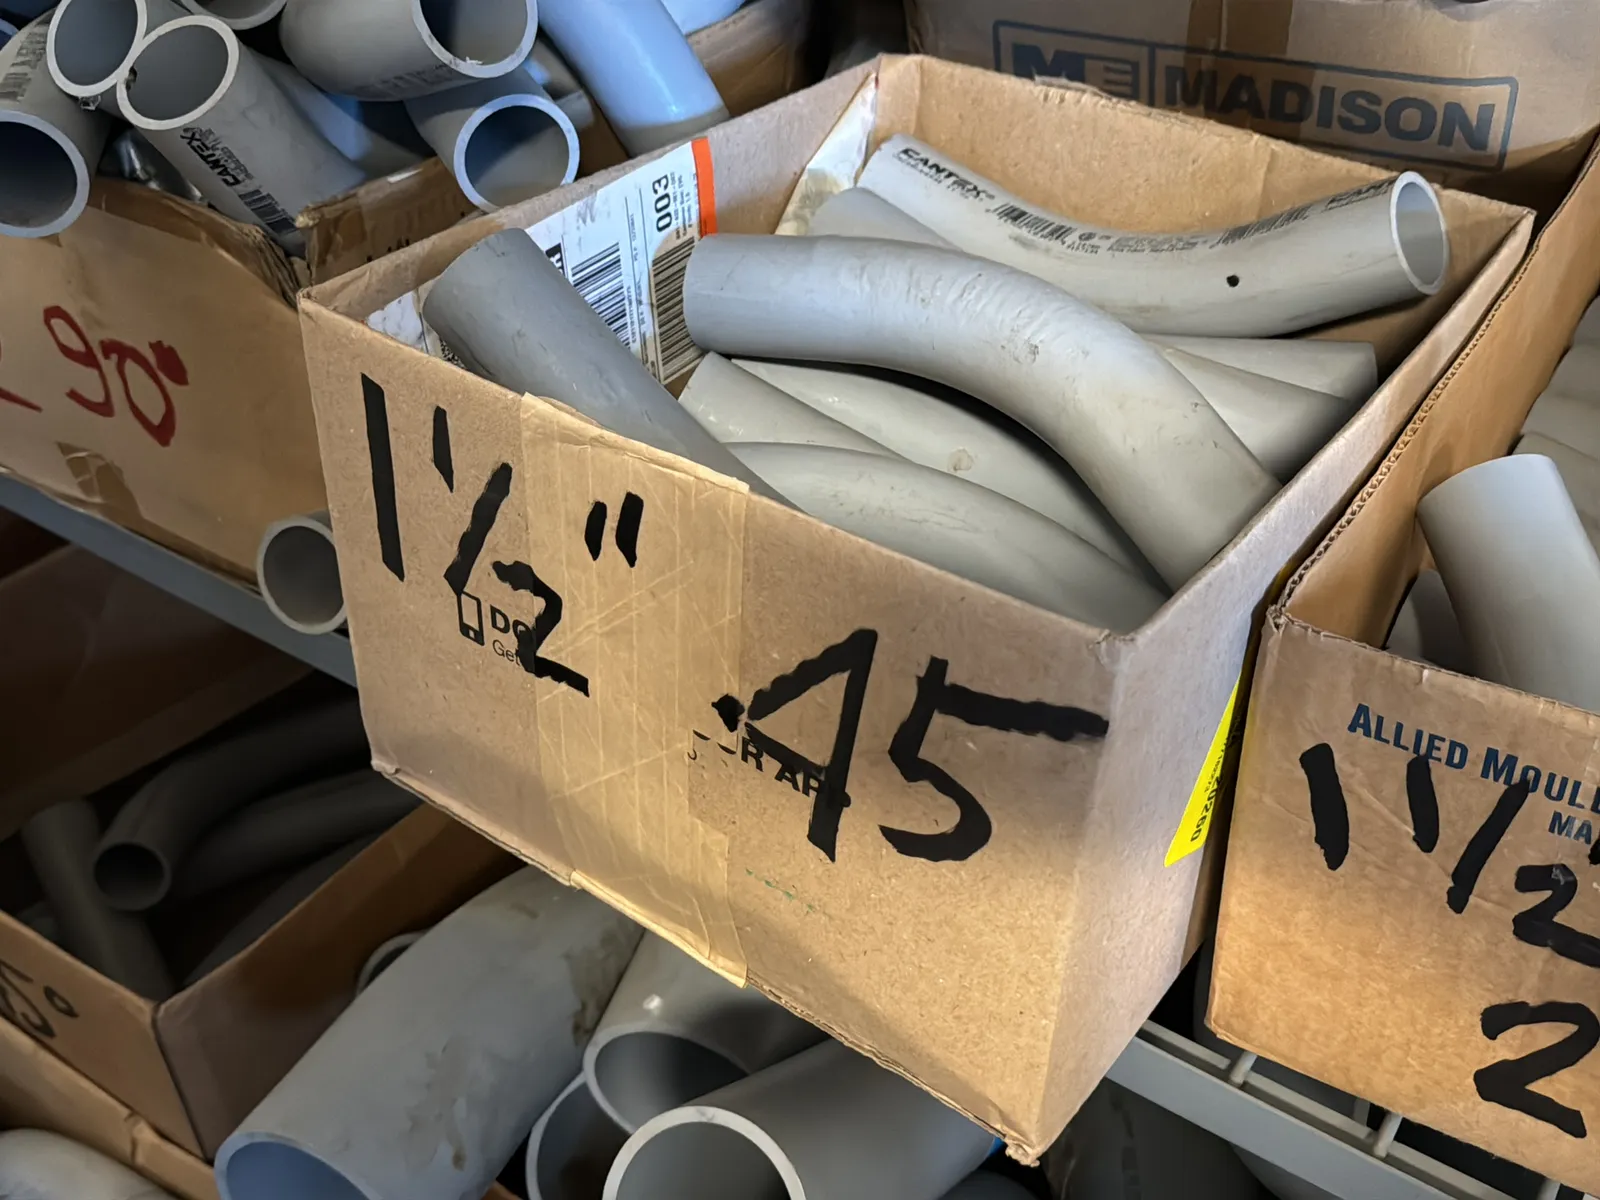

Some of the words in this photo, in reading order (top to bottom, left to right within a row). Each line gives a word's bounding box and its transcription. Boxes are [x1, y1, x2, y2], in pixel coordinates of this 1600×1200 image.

[1163, 64, 1497, 152] MADISON
[180, 131, 241, 187] CANTEX
[900, 147, 988, 200] CANTEX
[652, 174, 674, 233] 003
[711, 627, 1110, 864] 45
[1347, 703, 1469, 770] ALLIED
